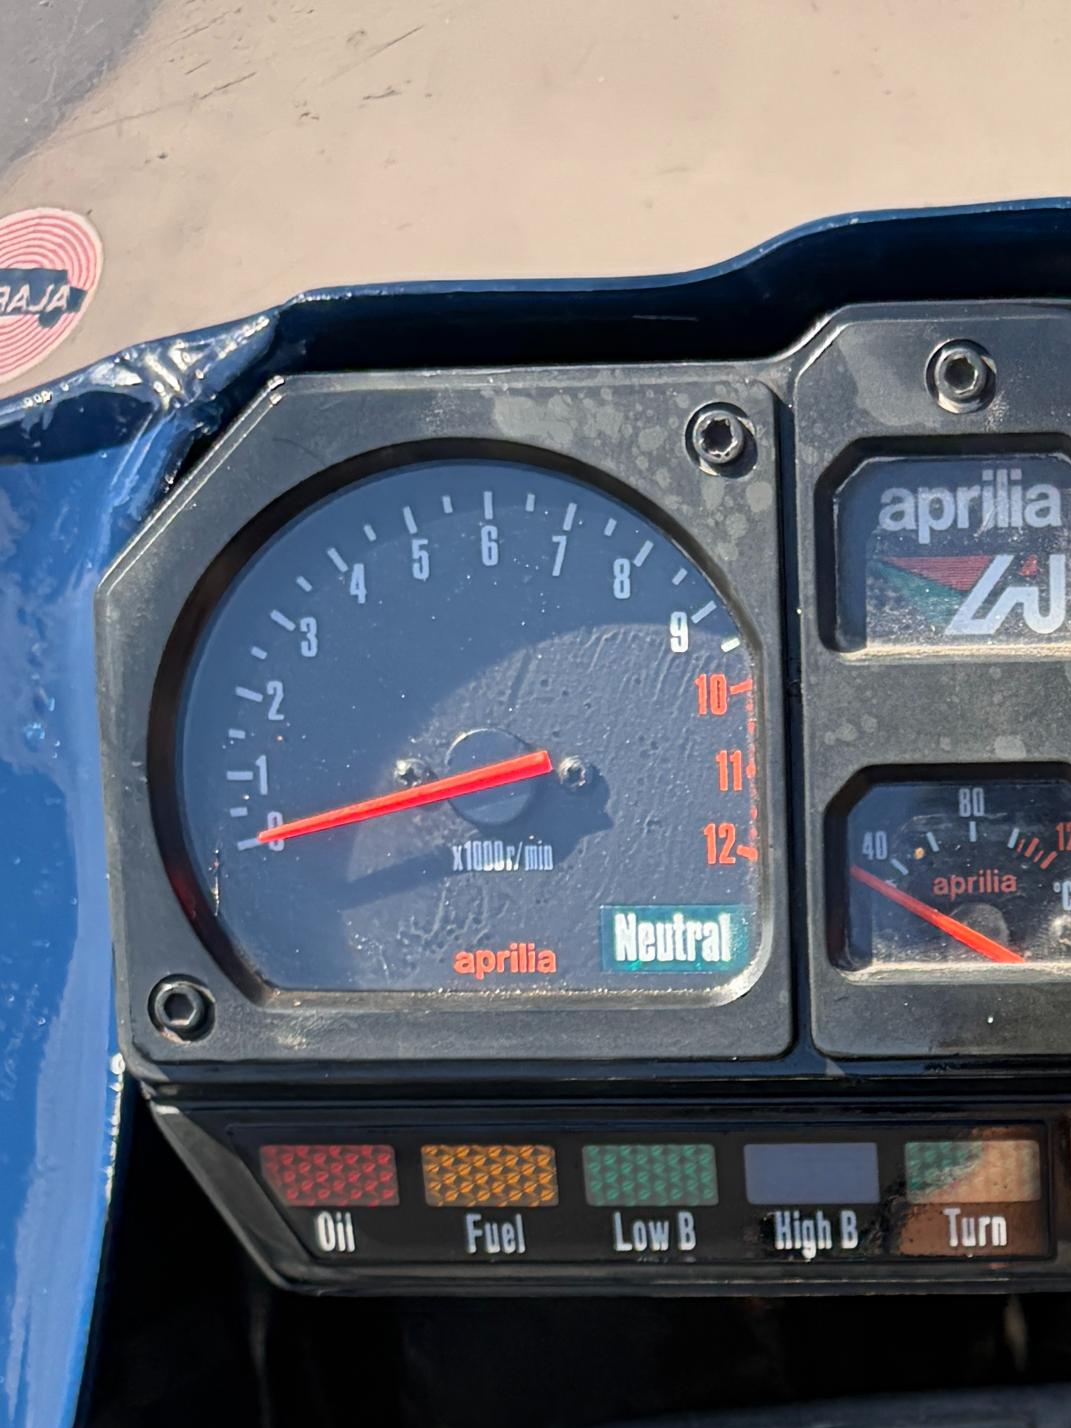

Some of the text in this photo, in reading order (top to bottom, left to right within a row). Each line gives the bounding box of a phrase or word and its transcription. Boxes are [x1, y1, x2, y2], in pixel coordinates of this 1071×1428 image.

[878, 468, 1062, 544] aprilia
[411, 538, 430, 580] 5
[480, 525, 498, 566] 6
[552, 535, 567, 577] 7
[350, 563, 367, 603] 4
[613, 558, 630, 599] 8
[300, 617, 318, 657] 3
[670, 611, 689, 652] 9
[266, 680, 284, 720] 2
[695, 673, 728, 715] 10
[255, 755, 268, 795] 1
[716, 750, 742, 792] 11
[959, 787, 984, 817] 80
[704, 823, 736, 865] 12
[863, 830, 888, 860] 40
[933, 870, 1017, 900] aprilia
[614, 912, 731, 963] Neutral
[453, 942, 557, 980] aprilia
[315, 1211, 356, 1253] Oil
[466, 1213, 526, 1254] Fuel
[614, 1211, 697, 1252] Low B
[774, 1209, 858, 1259] High B
[943, 1207, 1007, 1248] Turn
